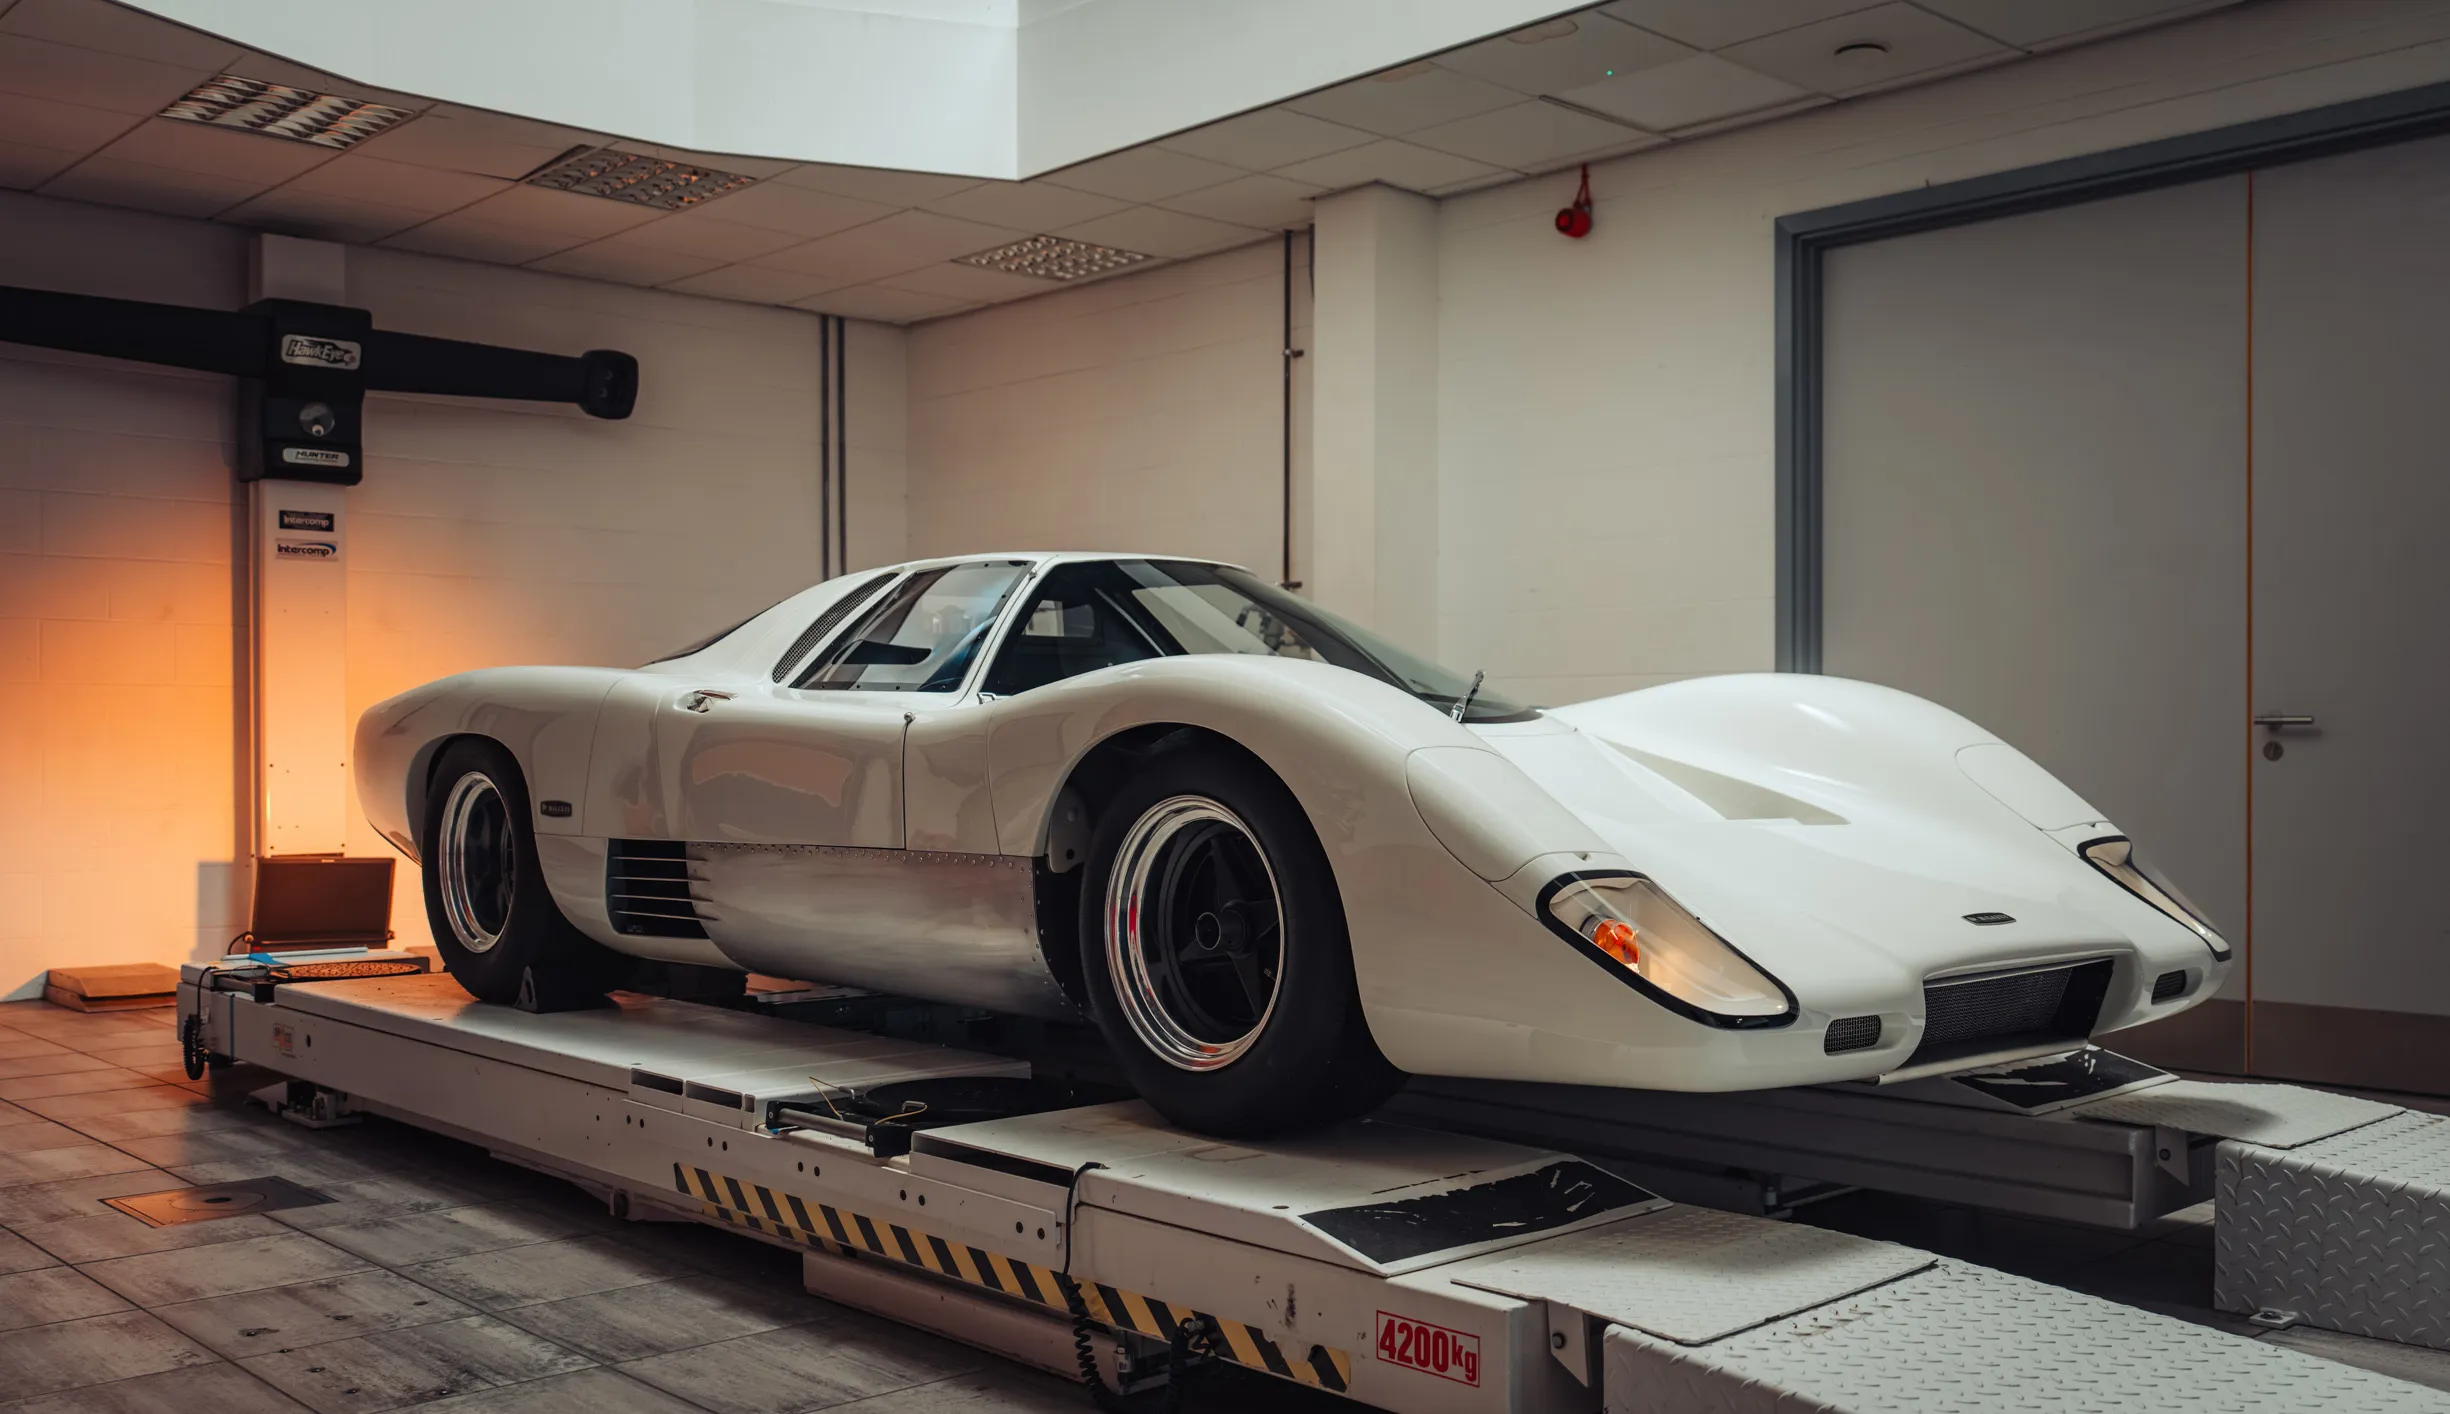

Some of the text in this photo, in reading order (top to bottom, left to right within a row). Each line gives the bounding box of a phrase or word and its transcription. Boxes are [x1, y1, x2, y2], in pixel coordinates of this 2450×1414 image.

[287, 340, 345, 361] HawkEye
[296, 451, 339, 460] HUNTER
[284, 514, 329, 528] Intercomp
[277, 543, 330, 558] Intercomp
[1379, 1318, 1477, 1382] 4200kg
